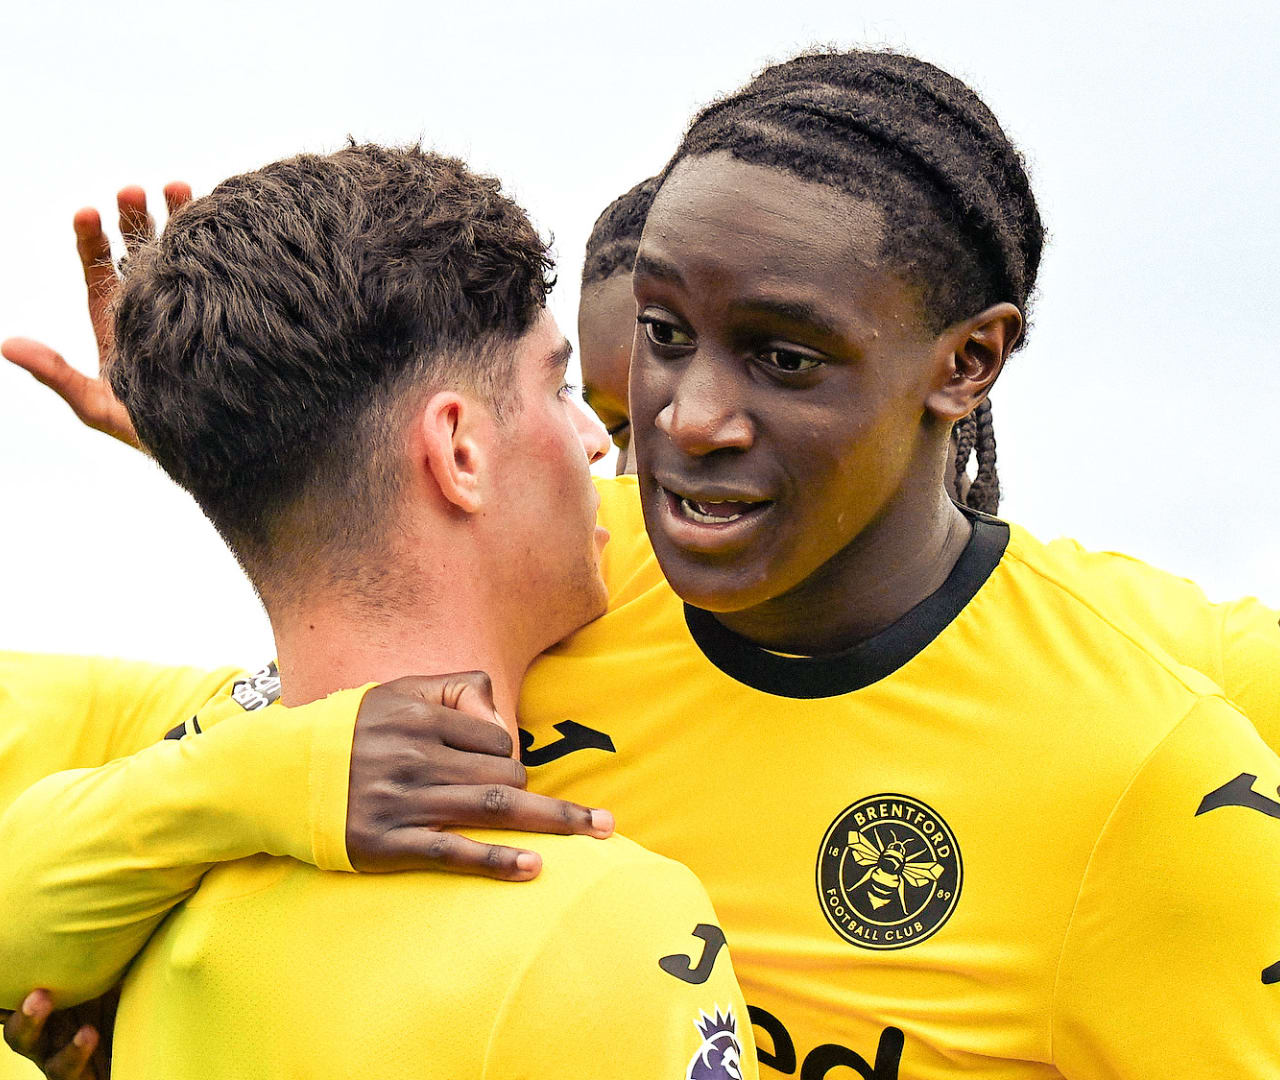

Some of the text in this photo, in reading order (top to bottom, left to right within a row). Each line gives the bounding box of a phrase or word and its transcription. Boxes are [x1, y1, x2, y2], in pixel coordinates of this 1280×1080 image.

[853, 803, 951, 858] BRENTFORD
[828, 846, 839, 857] 18
[936, 889, 951, 901] 89
[827, 888, 924, 941] FOOTBALL CLUB
